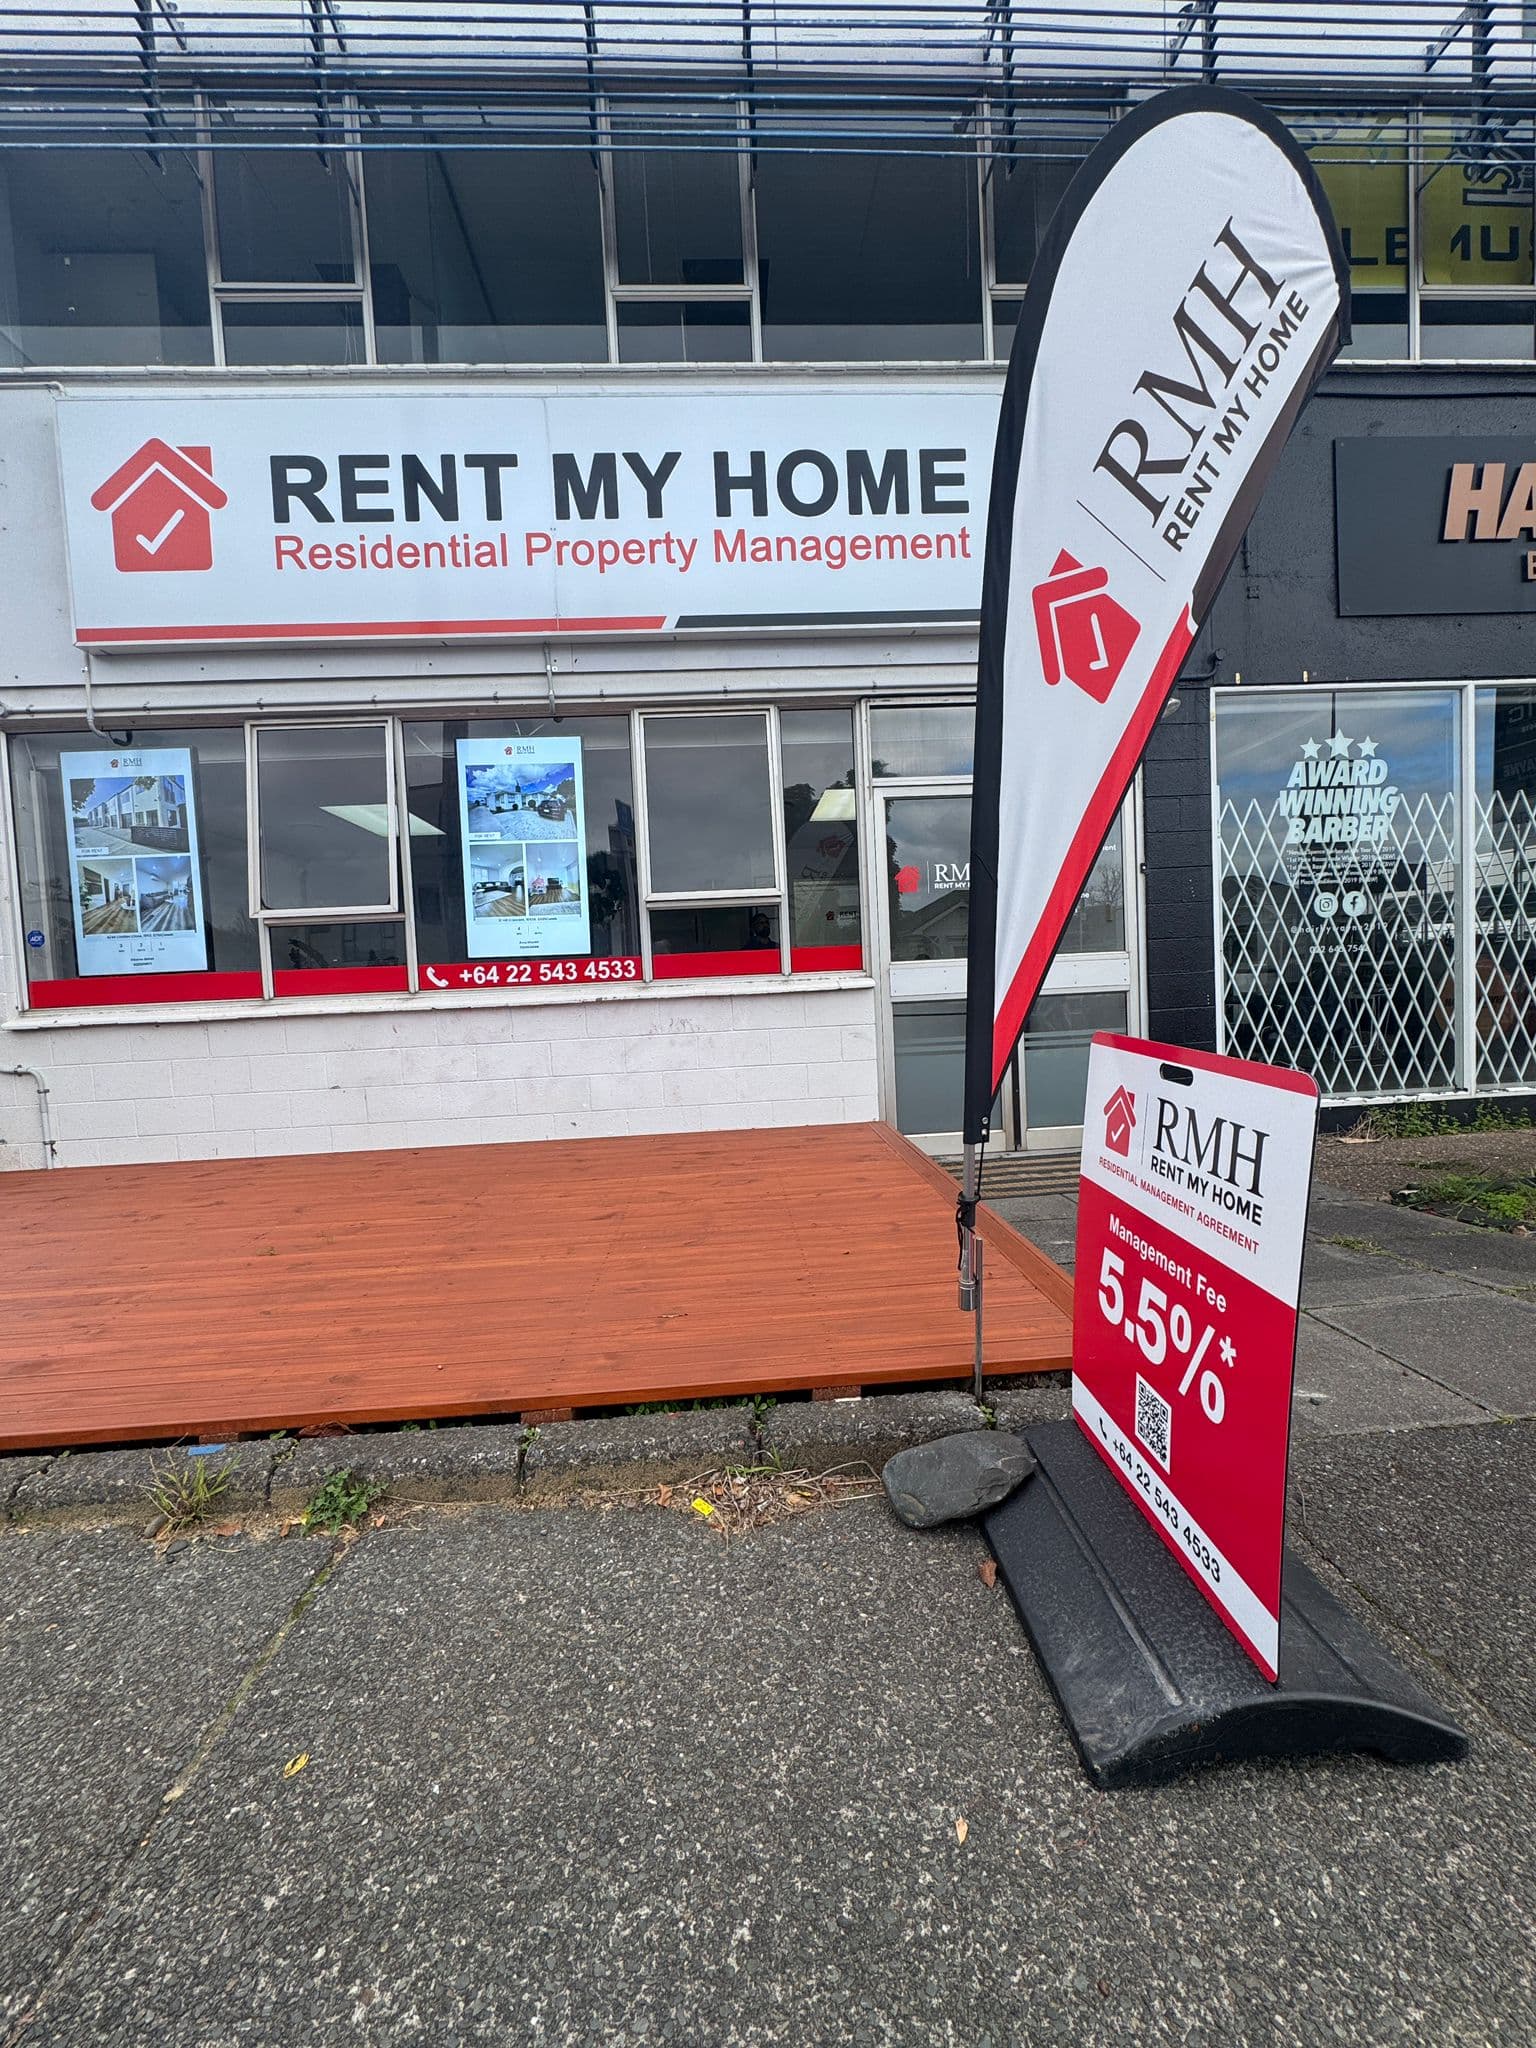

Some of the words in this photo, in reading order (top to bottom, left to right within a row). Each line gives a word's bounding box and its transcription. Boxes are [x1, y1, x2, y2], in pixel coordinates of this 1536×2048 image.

[1092, 215, 1287, 529] RMH
[1161, 450, 1221, 553] RENT
[1211, 392, 1251, 456] MY
[1242, 290, 1311, 400] HOME
[269, 453, 519, 524] RENT
[551, 451, 683, 521] MY
[712, 447, 971, 518] HOME
[274, 531, 509, 571] Residential
[524, 530, 699, 574] Property
[712, 525, 972, 571] Management
[1279, 785, 1400, 817] WINNING
[1286, 758, 1389, 789] AWARD
[1285, 814, 1390, 845] BARBER
[934, 862, 970, 882] RM
[459, 965, 500, 985] +64
[505, 963, 533, 983] 22
[539, 962, 578, 982] 543
[584, 959, 637, 979] 4533
[1152, 1096, 1271, 1199] RMH
[1098, 1156, 1139, 1188] RESIDENTIAL
[1139, 1179, 1196, 1219] MANAGEMENT
[1196, 1210, 1260, 1255] AGREEMENT
[1150, 1154, 1185, 1185] RENT
[1186, 1172, 1210, 1198] MY
[1211, 1184, 1264, 1227] HOME
[1108, 1212, 1193, 1290] Management
[1195, 1272, 1228, 1313] Fee
[1112, 1438, 1133, 1471] +64
[1135, 1462, 1151, 1495] 22
[1154, 1486, 1179, 1530] 543
[1182, 1525, 1221, 1584] 4533
